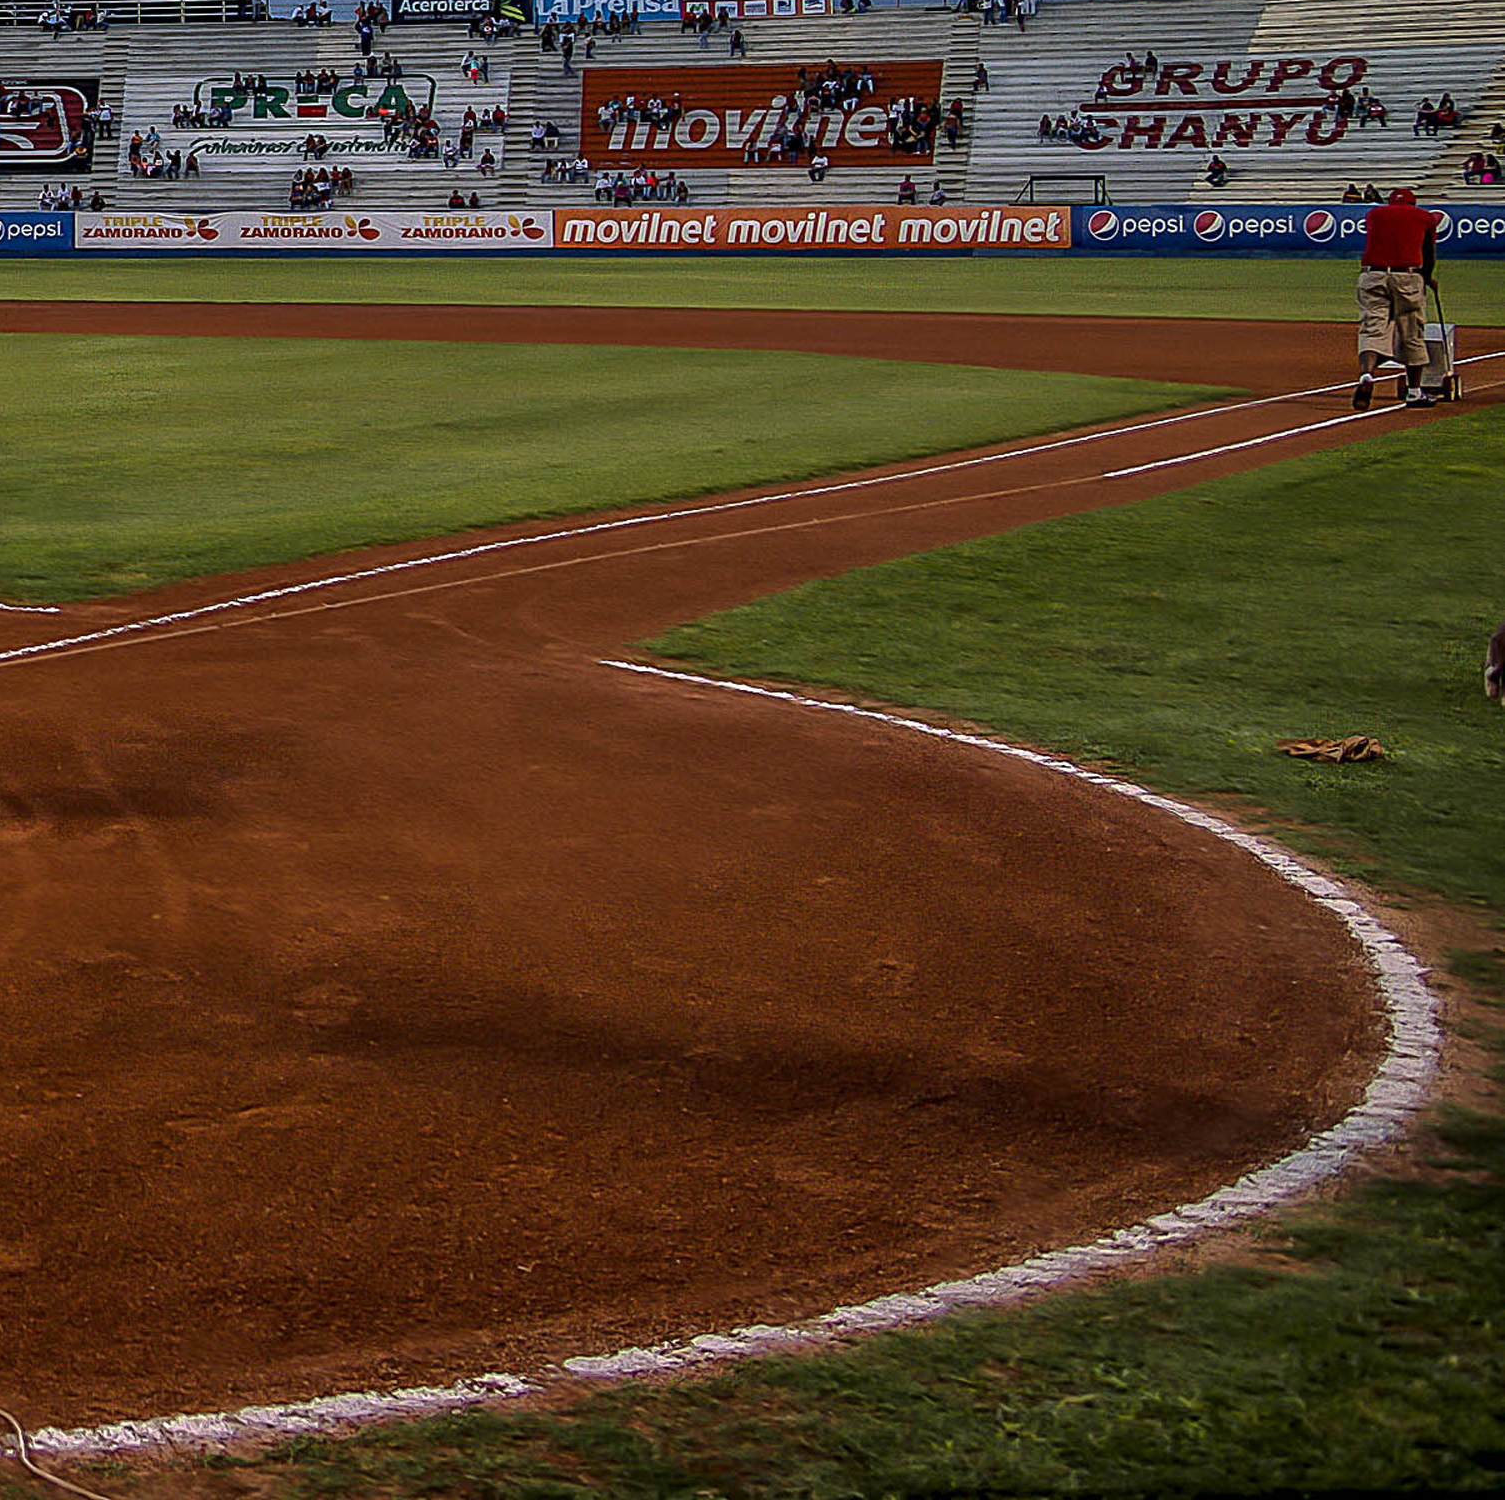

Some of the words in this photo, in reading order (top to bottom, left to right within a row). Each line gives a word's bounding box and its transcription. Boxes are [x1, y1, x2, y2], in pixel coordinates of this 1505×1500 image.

[1099, 56, 1369, 97] GRUPO
[103, 216, 162, 227] TRIPLE
[261, 216, 322, 226] TRIPLE
[422, 216, 485, 226] TRIPLE
[1122, 215, 1185, 237] pepsi
[1229, 215, 1293, 237] pepsi
[8, 220, 61, 240] pepsi
[83, 227, 182, 239] ZAMORANO
[240, 226, 343, 238] ZAMORANO
[401, 226, 506, 238] ZAMORANO
[562, 214, 717, 244] movilnet
[727, 213, 886, 244] movilnet
[898, 211, 1062, 243] movilnet
